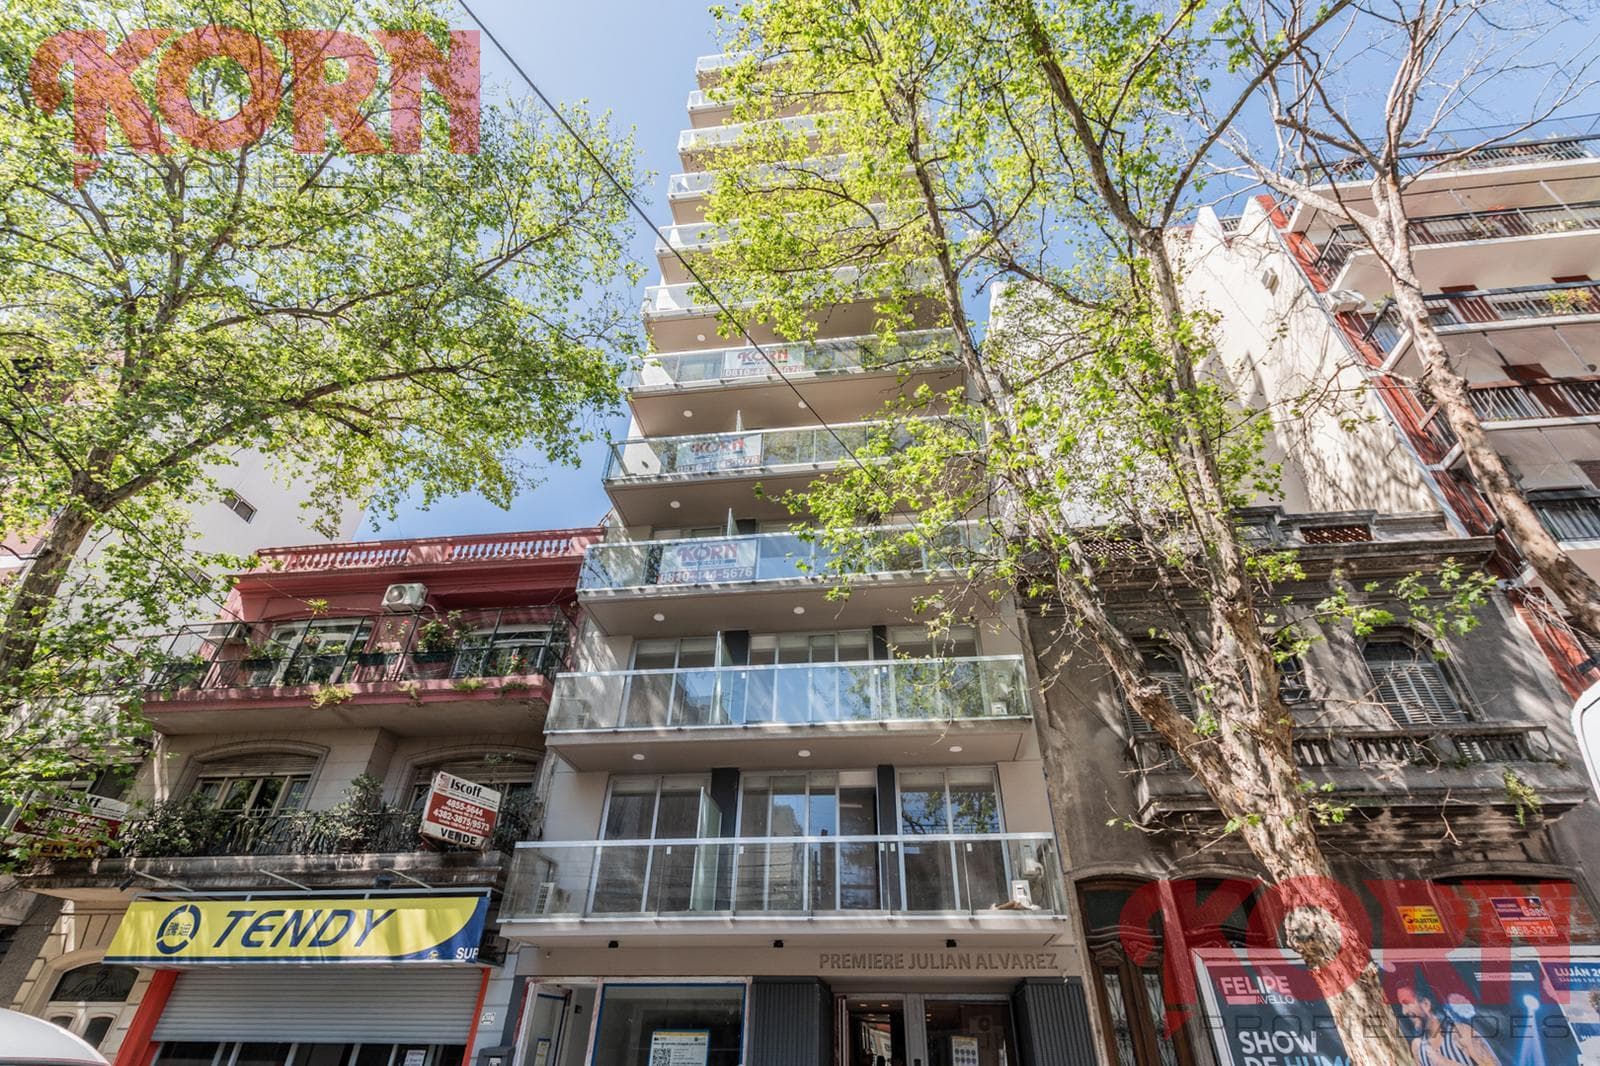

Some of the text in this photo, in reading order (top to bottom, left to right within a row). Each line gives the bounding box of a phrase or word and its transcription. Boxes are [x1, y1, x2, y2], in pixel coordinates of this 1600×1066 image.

[676, 543, 737, 562] KORN
[451, 778, 482, 798] Iscoff
[440, 827, 477, 846] VENDE
[213, 908, 396, 948] TENDY
[820, 952, 1058, 970] PREMIERE JULIAN ALVAREZ
[1554, 966, 1591, 977] LUJÁN
[1220, 976, 1291, 995] FELIPE
[1256, 995, 1295, 1005] AVELLO
[1238, 1031, 1317, 1054] SHOW
